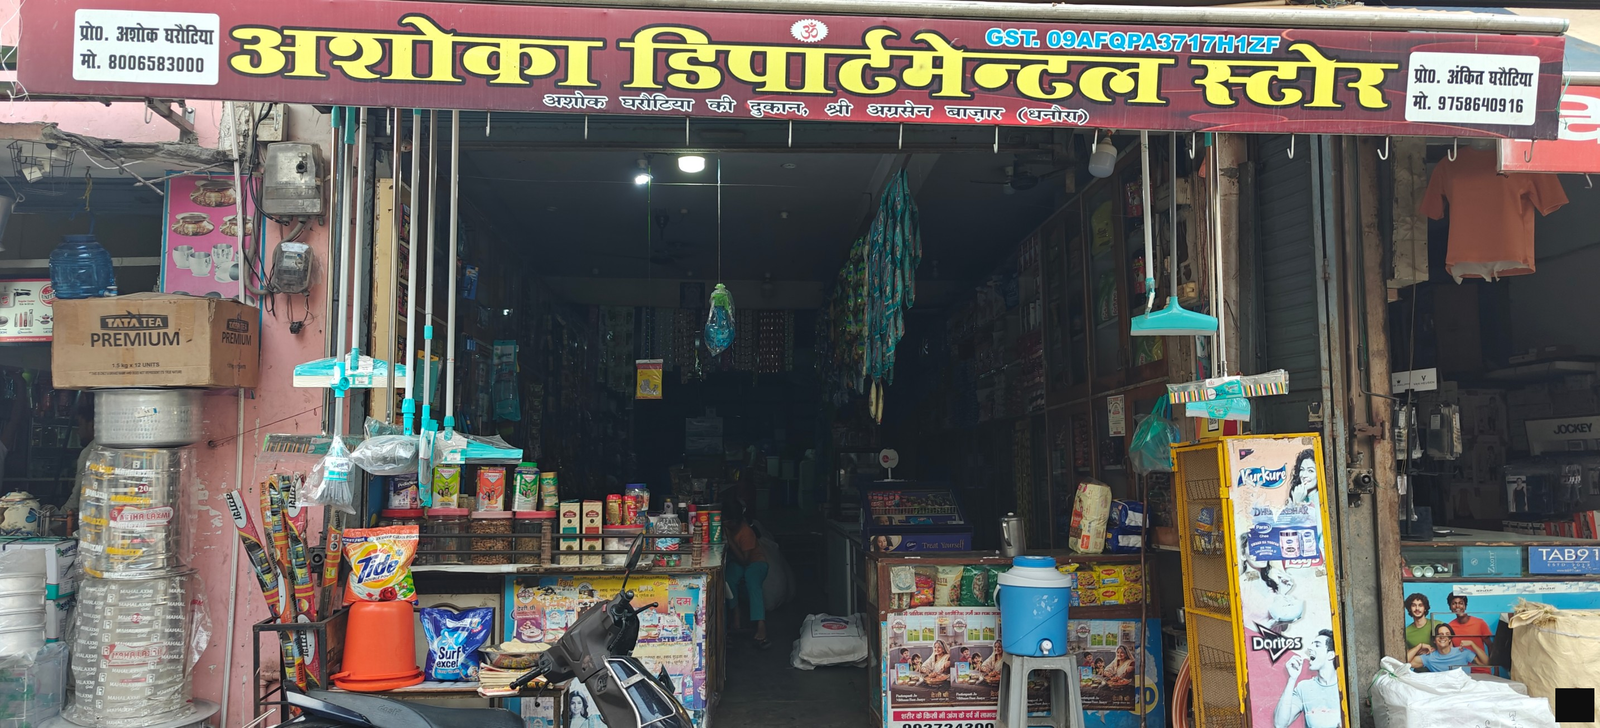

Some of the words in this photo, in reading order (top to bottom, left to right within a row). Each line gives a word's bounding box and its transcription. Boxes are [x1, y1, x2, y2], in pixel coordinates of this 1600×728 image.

[117, 23, 159, 43] अशोक
[986, 28, 1039, 48] GST.
[1047, 29, 1280, 54] 09AFQPA3717H1ZF
[80, 50, 101, 70] मो.
[109, 54, 205, 74] 8006583000
[230, 15, 604, 88] अशोका
[618, 26, 1175, 105] डिपार्टमेन्टल
[1190, 43, 1399, 109] स्टोर
[1448, 66, 1484, 87] अंकित
[543, 91, 607, 110] अशोक
[707, 94, 735, 114] की
[748, 99, 810, 118] दुकान,
[825, 99, 853, 118] श्री
[867, 102, 934, 120] अग्रसेन
[1413, 94, 1431, 111] मो.
[1438, 95, 1524, 114] 9758640916
[106, 318, 140, 328] TATA
[141, 318, 163, 327] TEA
[90, 331, 180, 347] PREMIUM
[221, 331, 252, 346] PREMIUM
[1553, 423, 1592, 434] JOCKEY
[1239, 465, 1287, 486] Kurkure
[147, 512, 170, 520] LAXMI
[940, 539, 964, 550] Yourself
[1538, 548, 1600, 561] TAB91
[357, 553, 400, 584] Tide
[676, 597, 693, 606] दम
[1252, 637, 1302, 650] Doritos
[438, 646, 461, 660] Surf
[436, 660, 458, 668] excel
[923, 712, 937, 720] किसी
